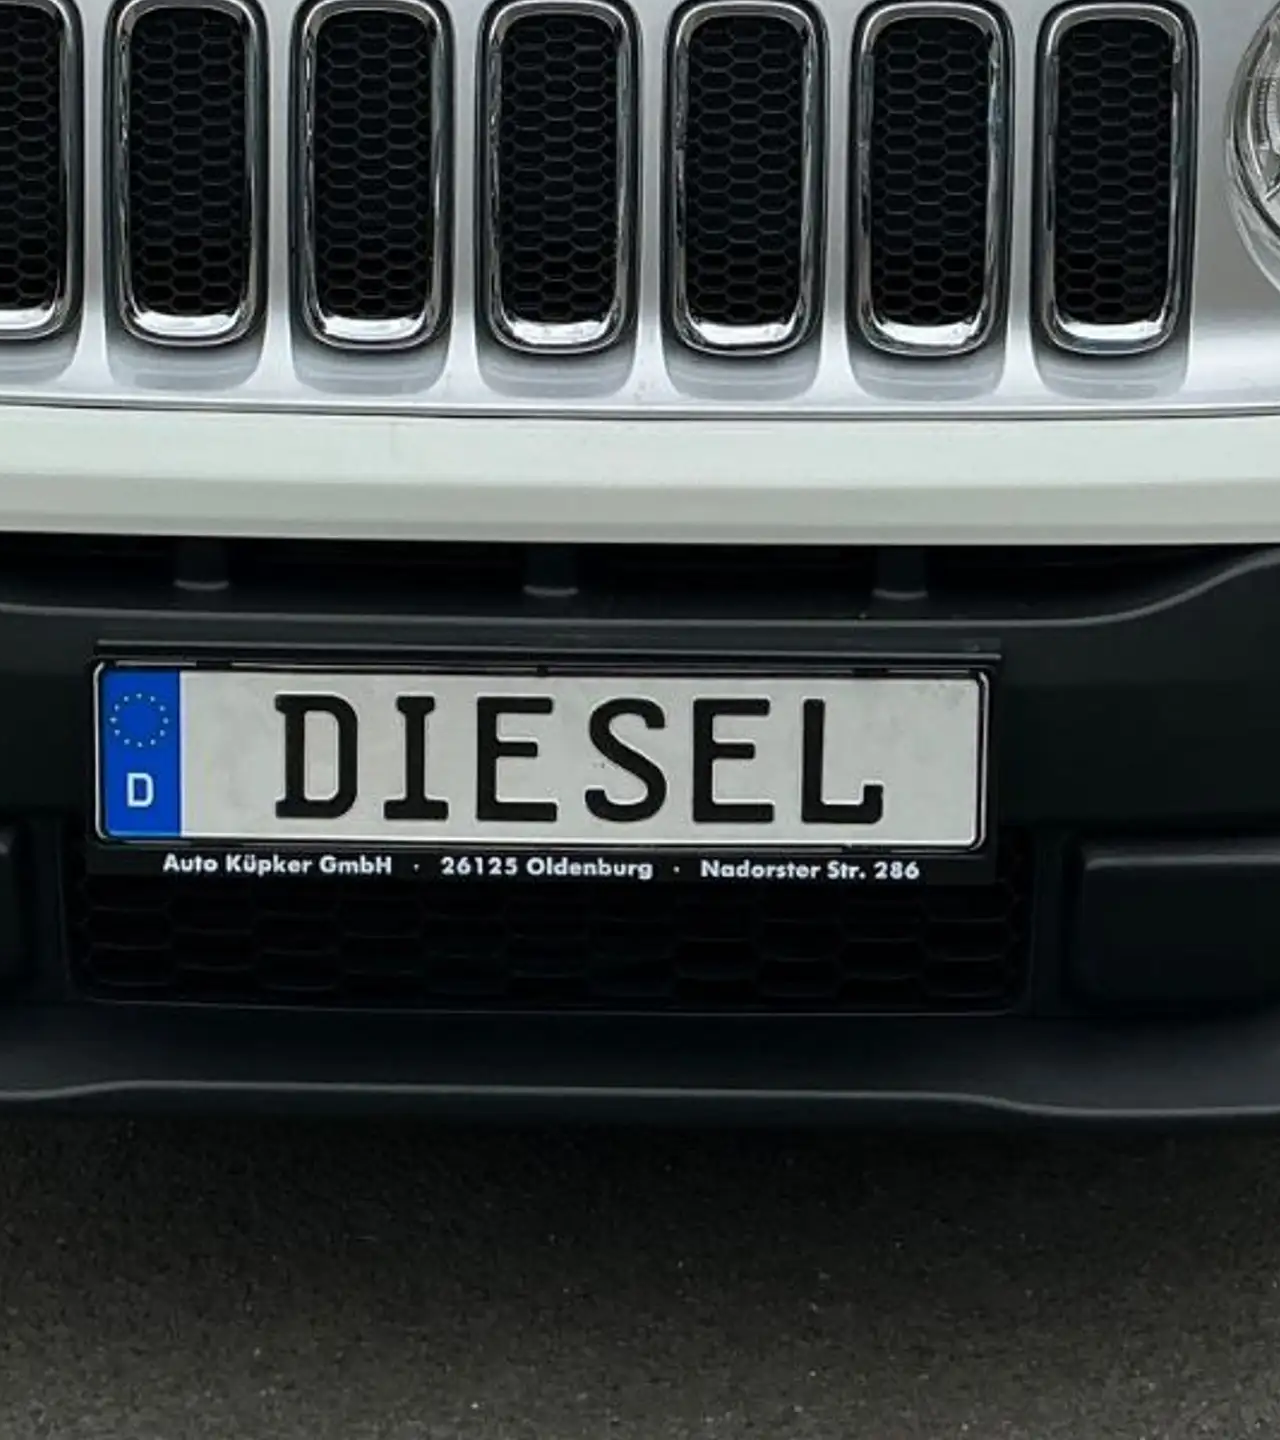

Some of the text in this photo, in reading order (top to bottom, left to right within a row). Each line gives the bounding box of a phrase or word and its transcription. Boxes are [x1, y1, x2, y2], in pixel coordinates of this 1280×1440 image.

[273, 692, 885, 825] DIESEL
[125, 772, 155, 809] D
[162, 853, 920, 880] Auto Küpker GmbH 26125 Oldenburg Nadorster Str. 286
